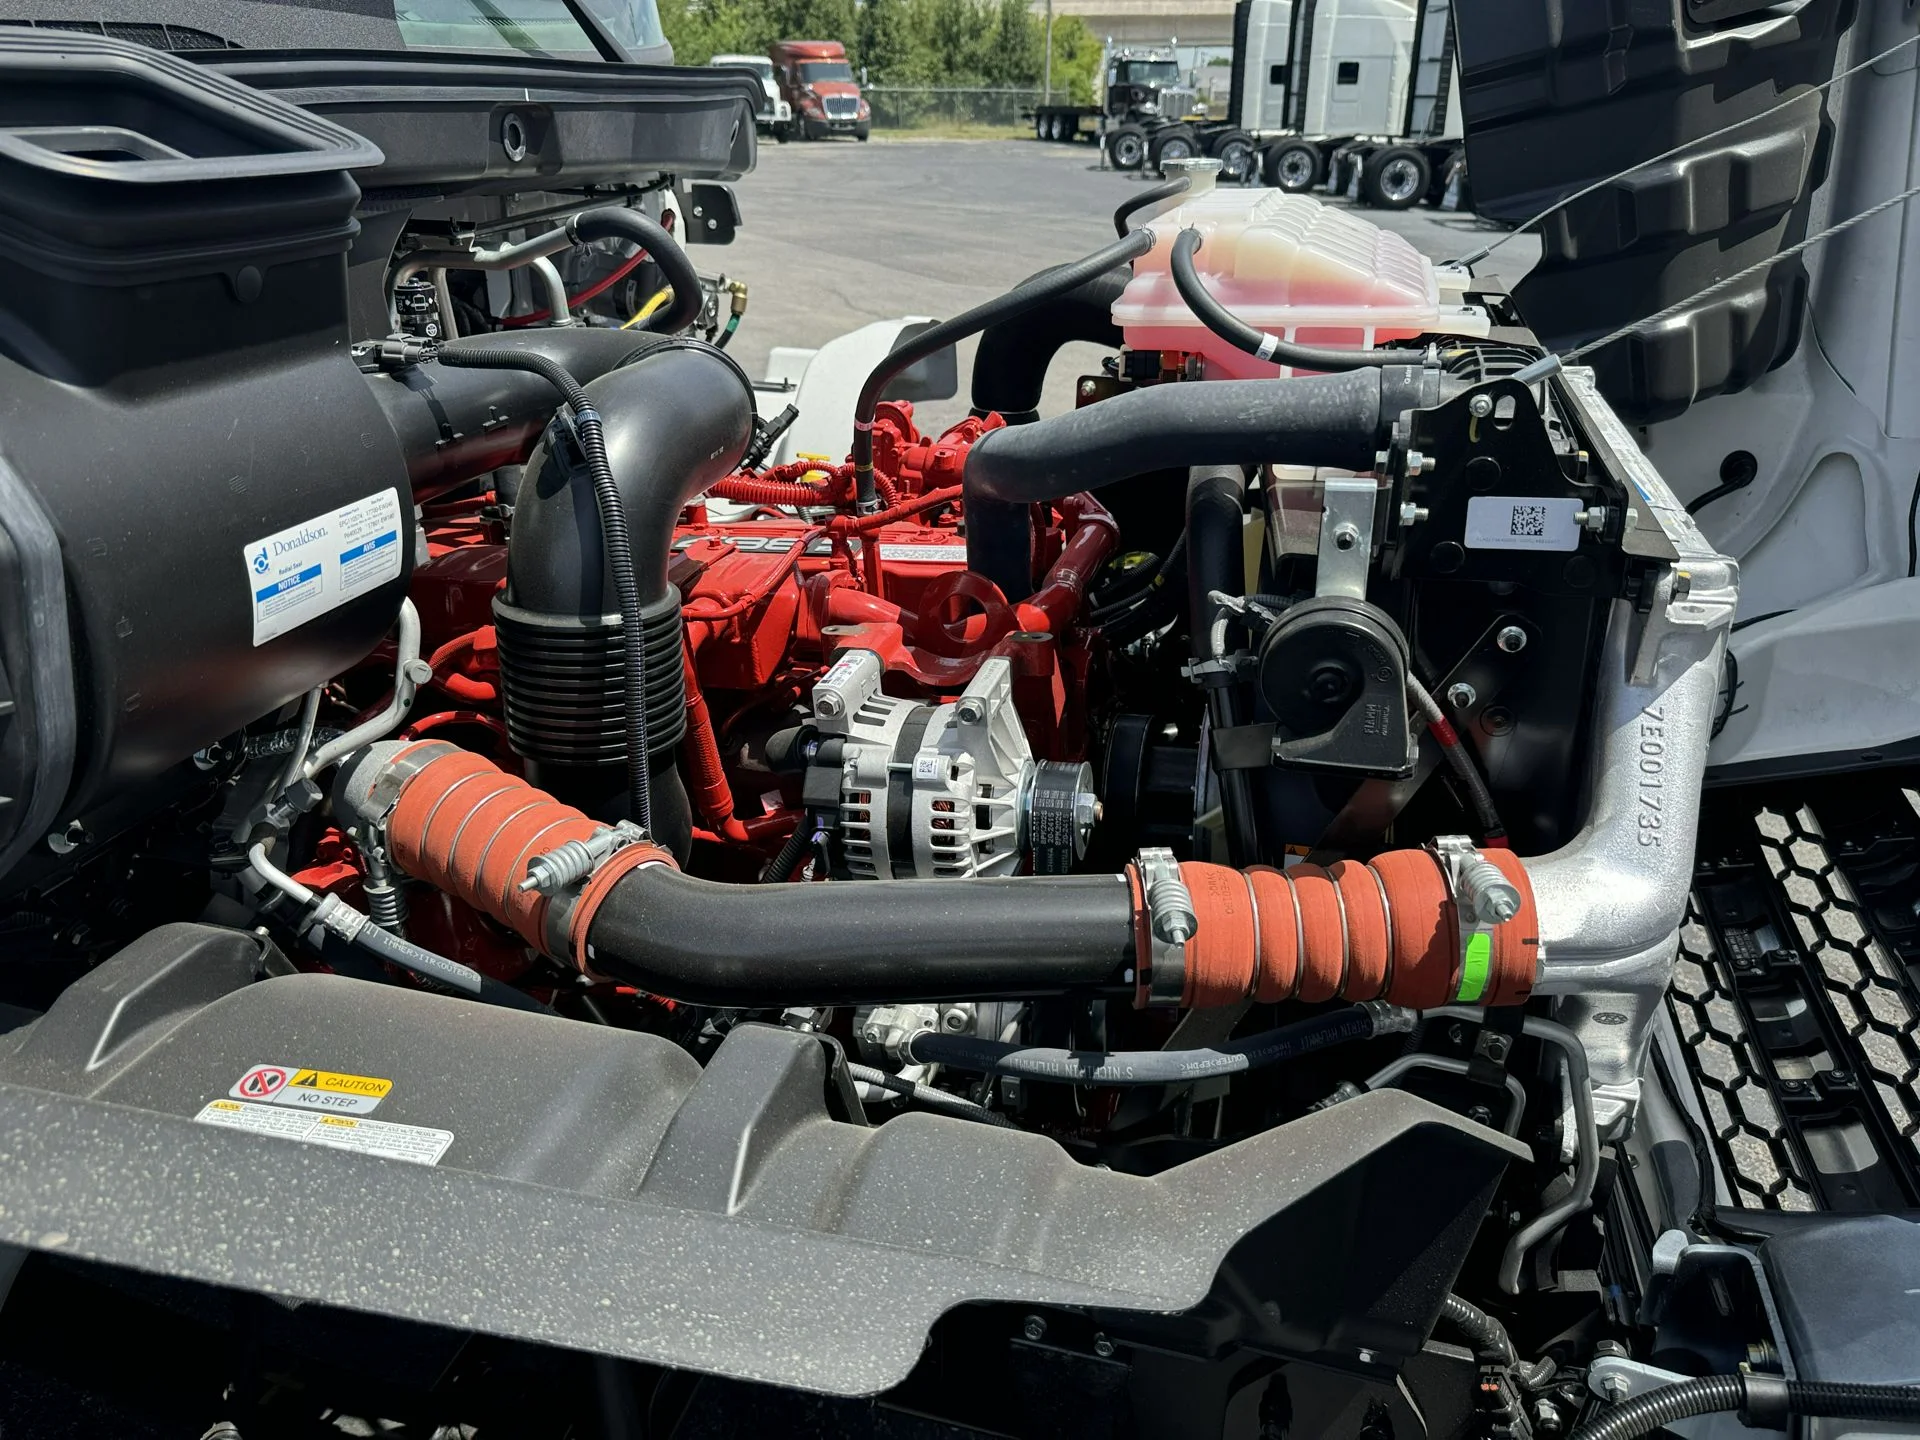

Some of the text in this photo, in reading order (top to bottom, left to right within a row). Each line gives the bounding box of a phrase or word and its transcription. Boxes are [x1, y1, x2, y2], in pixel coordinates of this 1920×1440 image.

[363, 540, 376, 553] AVIS
[278, 575, 301, 592] NOTICE
[1637, 705, 1665, 848] 7E001735
[324, 1077, 387, 1093] CAUTION
[297, 1093, 358, 1108] NO STEP
